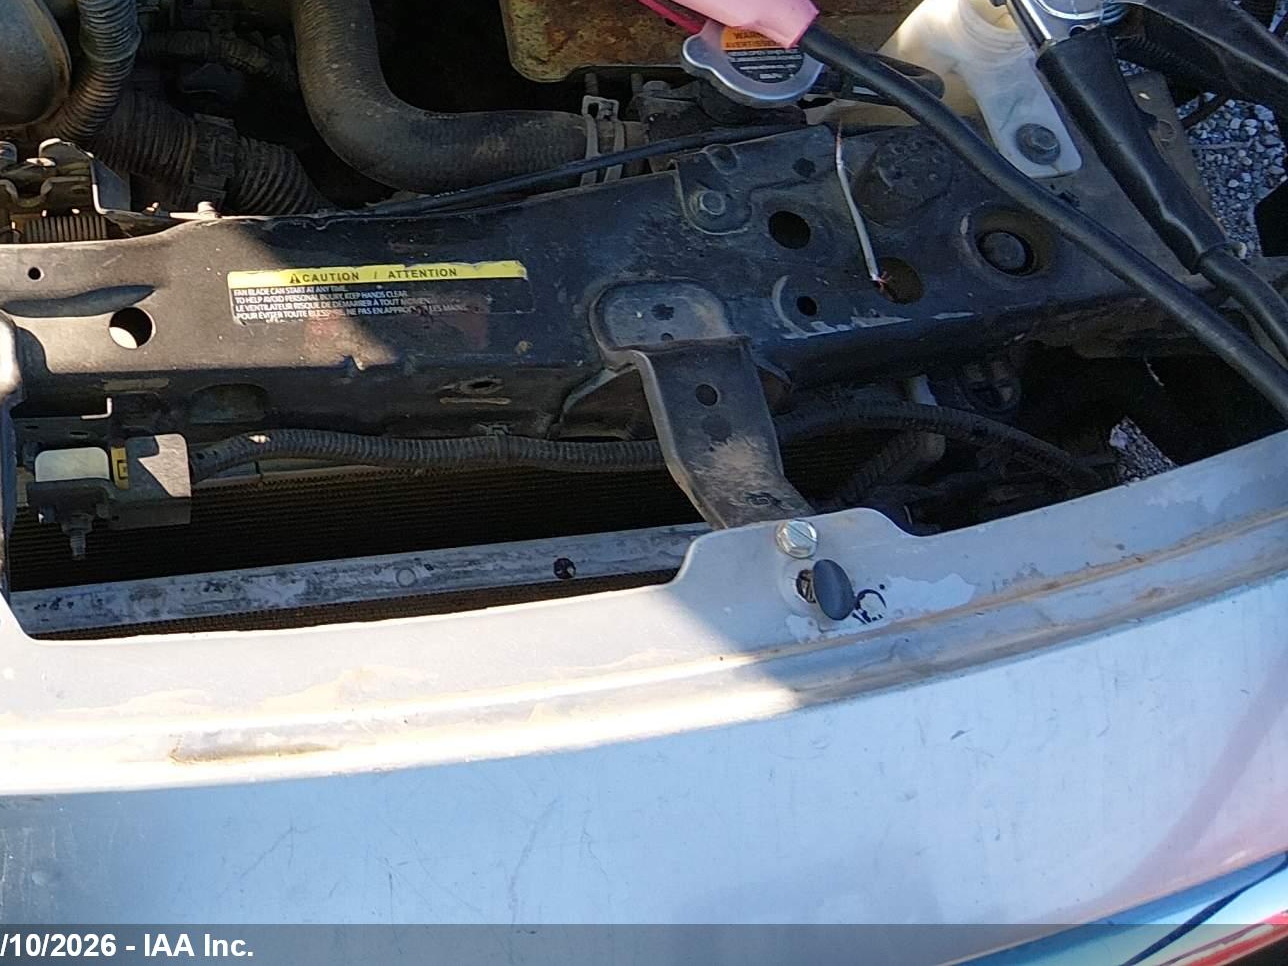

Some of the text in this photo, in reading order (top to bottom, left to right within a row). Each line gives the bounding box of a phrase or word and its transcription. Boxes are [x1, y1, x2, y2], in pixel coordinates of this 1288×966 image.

[303, 272, 359, 282] CAUTION
[388, 268, 457, 279] ATTENTION
[361, 290, 385, 298] HANDS
